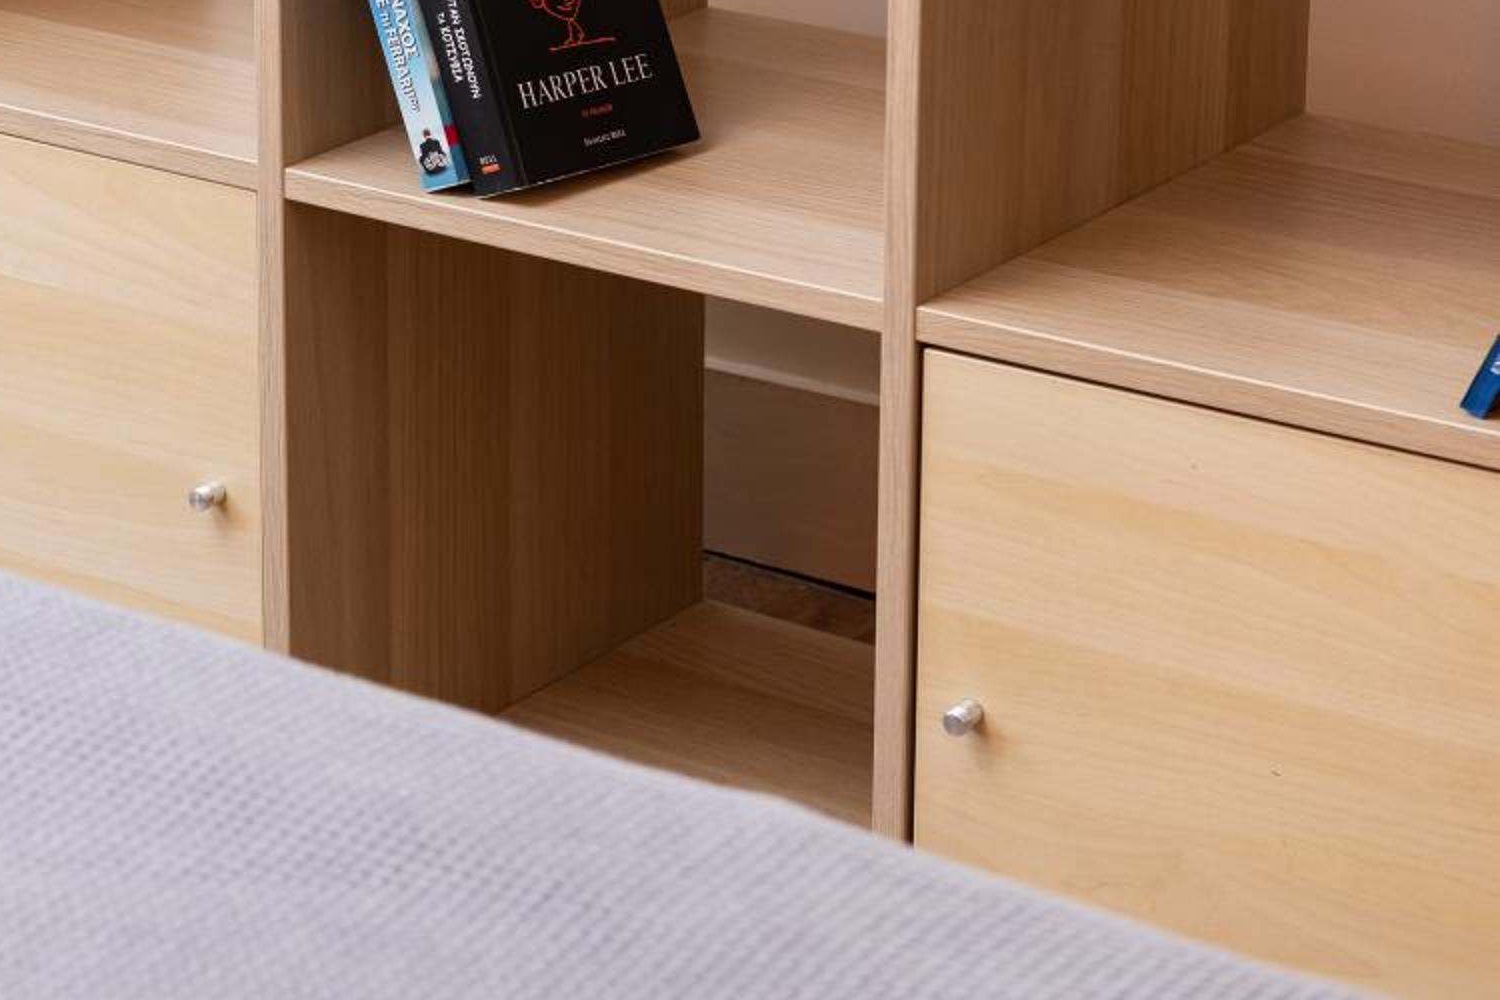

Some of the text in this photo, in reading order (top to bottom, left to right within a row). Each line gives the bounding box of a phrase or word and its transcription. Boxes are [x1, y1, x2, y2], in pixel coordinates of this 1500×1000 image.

[386, 27, 415, 96] FERRARI
[518, 53, 653, 109] HARPER LEE
